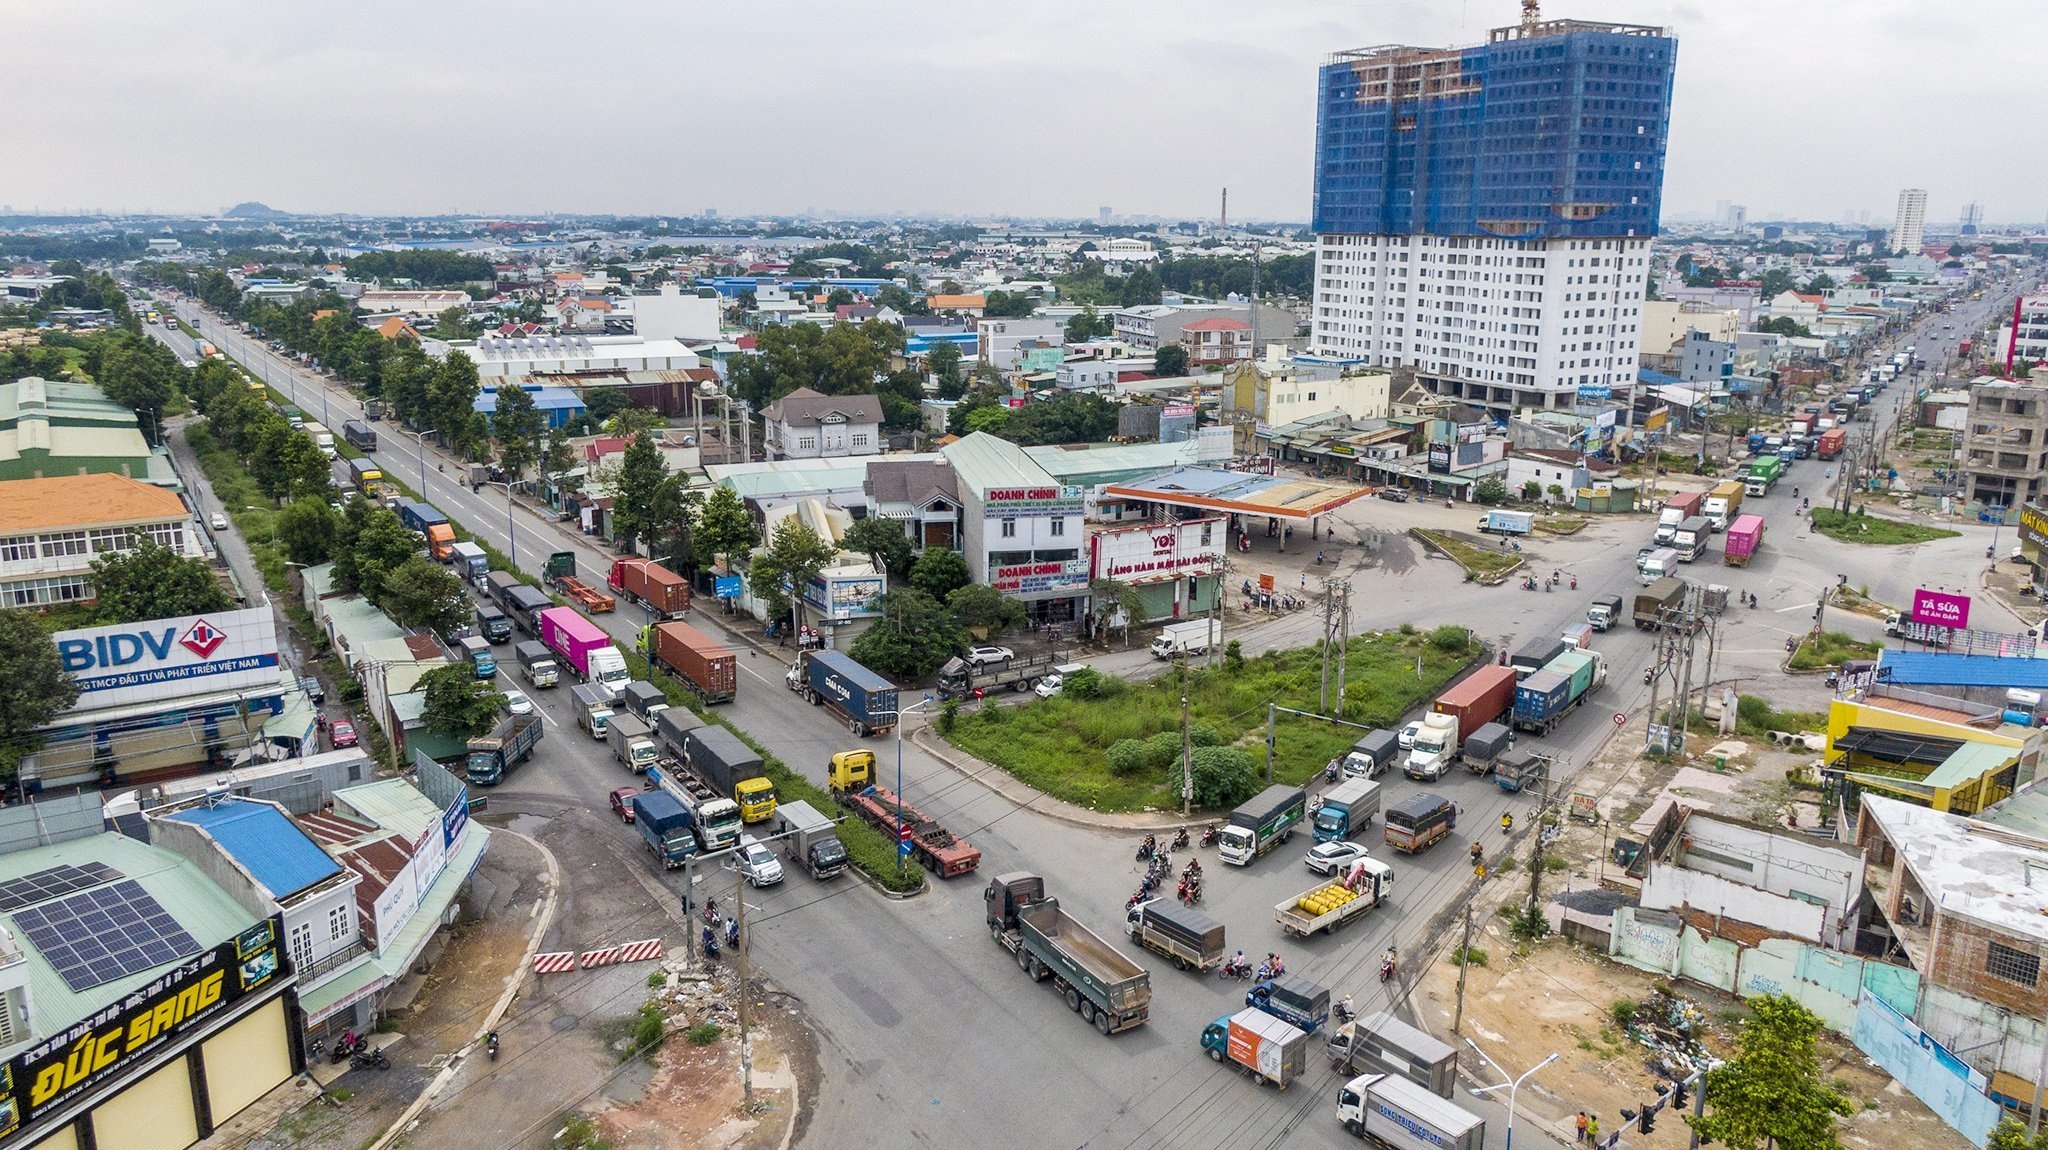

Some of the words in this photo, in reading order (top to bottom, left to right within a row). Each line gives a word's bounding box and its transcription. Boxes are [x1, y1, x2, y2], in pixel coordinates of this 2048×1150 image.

[991, 490, 1024, 500] DOANH
[1028, 487, 1056, 499] CHÍNH
[999, 566, 1032, 578] DOANH
[1034, 562, 1061, 575] CHÍNH
[1134, 562, 1154, 572] HÀM
[1937, 602, 1960, 614] SỮA
[58, 627, 176, 672] BIDV
[554, 625, 571, 652] ONE
[91, 678, 117, 689] TMCP
[119, 671, 138, 686] ĐẦU
[139, 669, 154, 682] TƯ
[154, 667, 166, 680] VÀ
[167, 664, 190, 679] PHÁT
[192, 661, 217, 675] TRIỂN
[218, 660, 237, 673] VIỆT
[238, 658, 260, 669] NAM
[31, 1026, 123, 1107] ĐỨC
[126, 969, 225, 1052] SANG
[50, 1031, 67, 1051] TÂM
[1379, 1105, 1395, 1121] SONG
[1429, 1132, 1443, 1146] LTD
